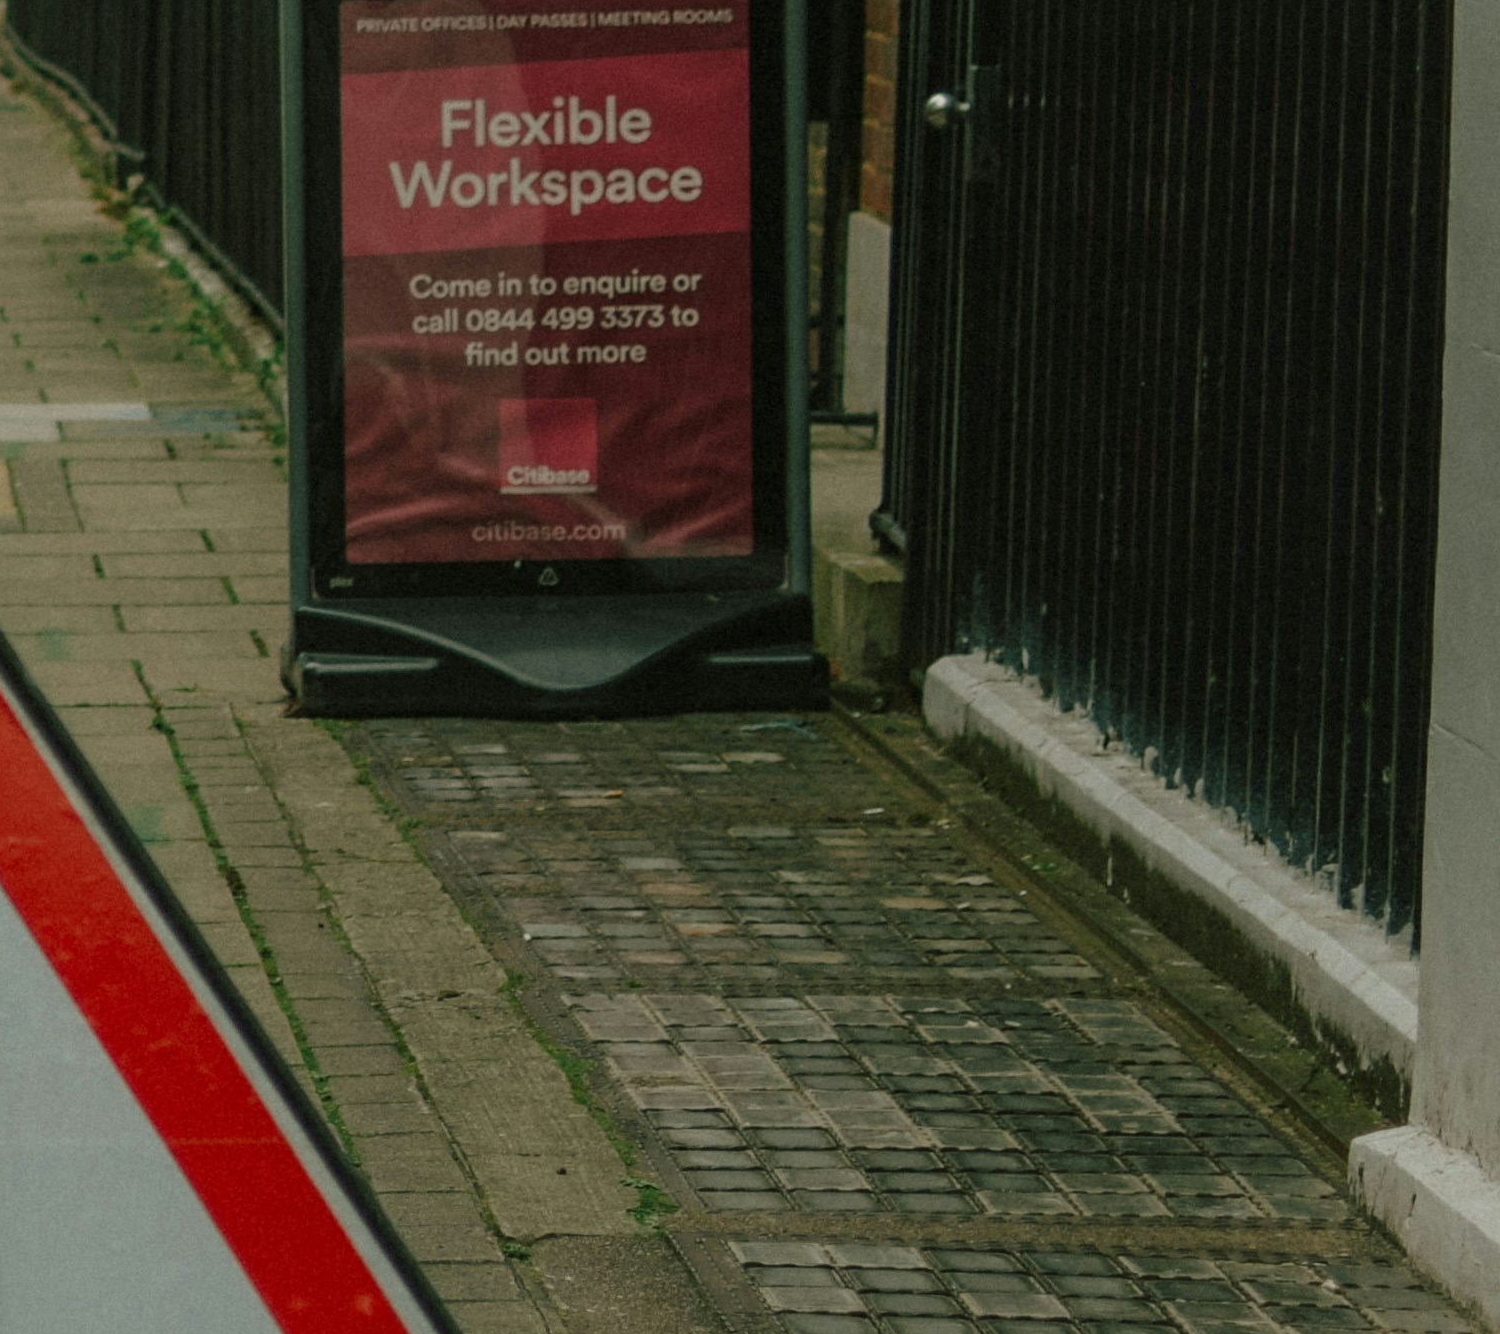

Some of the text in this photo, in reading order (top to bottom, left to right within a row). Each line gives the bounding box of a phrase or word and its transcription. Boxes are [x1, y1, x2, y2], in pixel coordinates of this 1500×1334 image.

[356, 8, 734, 33] PRIVATE OFFICES DAY PASSES MEETING ROOMS
[440, 95, 652, 148] Flexible
[388, 157, 703, 216] Workspace
[409, 268, 703, 299] Come in to enquire or
[411, 304, 699, 334] call 0844 499 3373 to
[464, 341, 647, 366] find out more
[506, 465, 591, 486] Citibase
[471, 521, 627, 543] citibase.com
